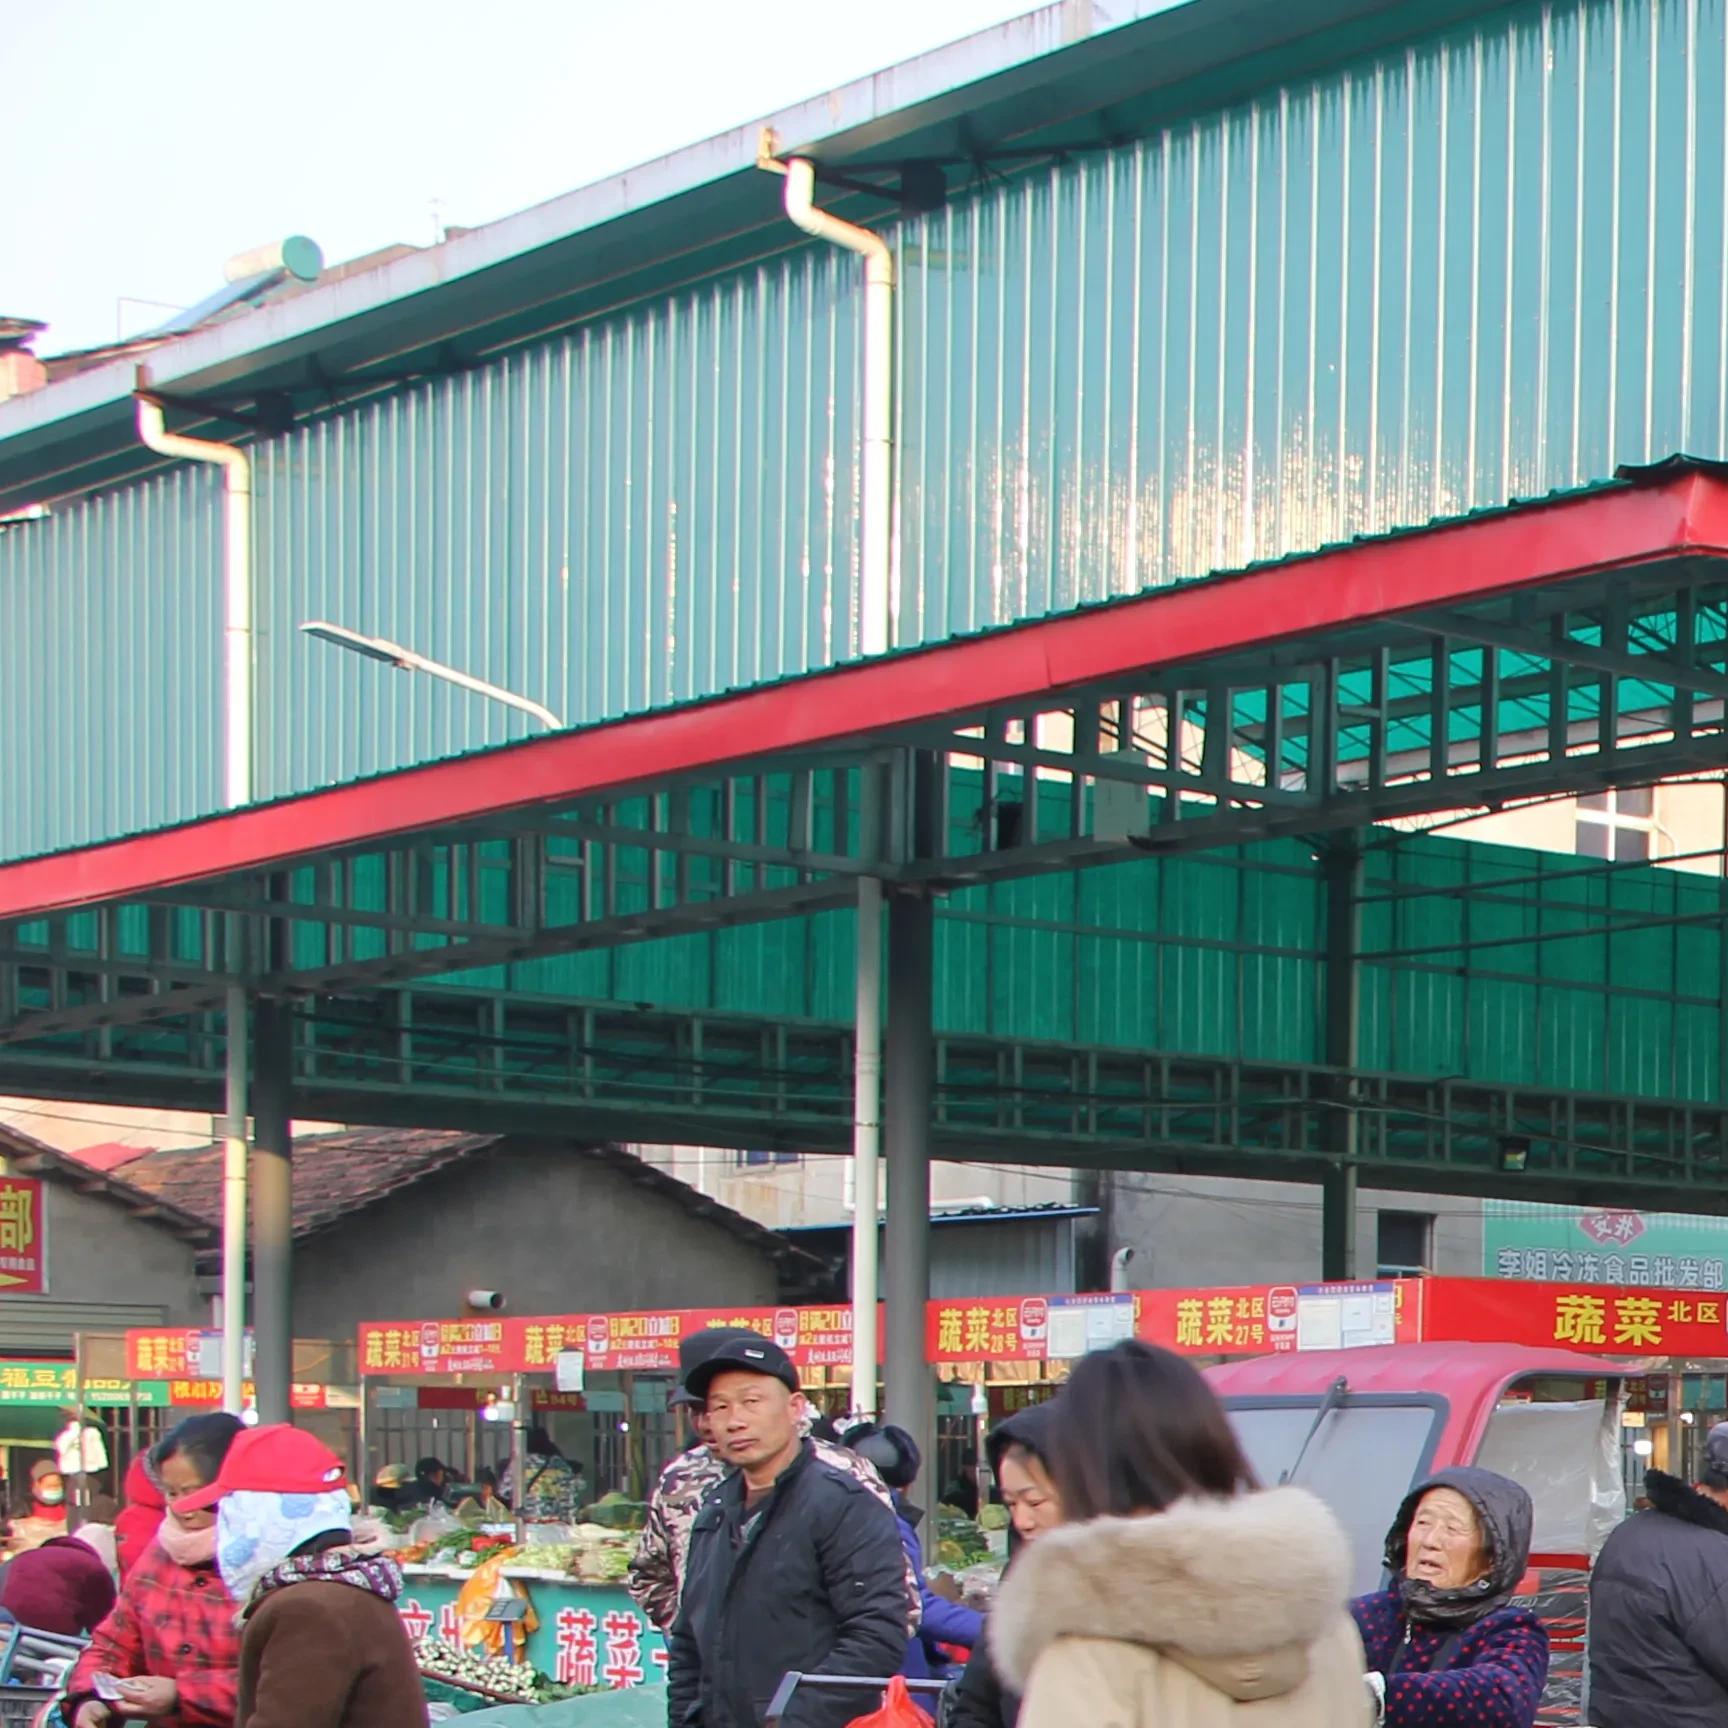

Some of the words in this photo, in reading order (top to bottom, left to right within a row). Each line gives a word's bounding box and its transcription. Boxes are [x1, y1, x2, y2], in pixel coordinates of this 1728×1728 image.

[0, 1184, 33, 1253] 部
[1498, 1249, 1726, 1290] 李姐冷冻食品批发部
[938, 1306, 991, 1353] 蔬菜
[992, 1307, 1019, 1328] 北区
[1176, 1297, 1235, 1347] 蔬菜
[1236, 1297, 1265, 1319] 北区
[1235, 1323, 1265, 1346] 27号
[1554, 1294, 1663, 1347] 蔬菜
[1667, 1300, 1720, 1324] 北区
[365, 1329, 402, 1368] 蔬菜
[524, 1325, 564, 1365] 蔬菜
[556, 1606, 645, 1690] 蔬菜
